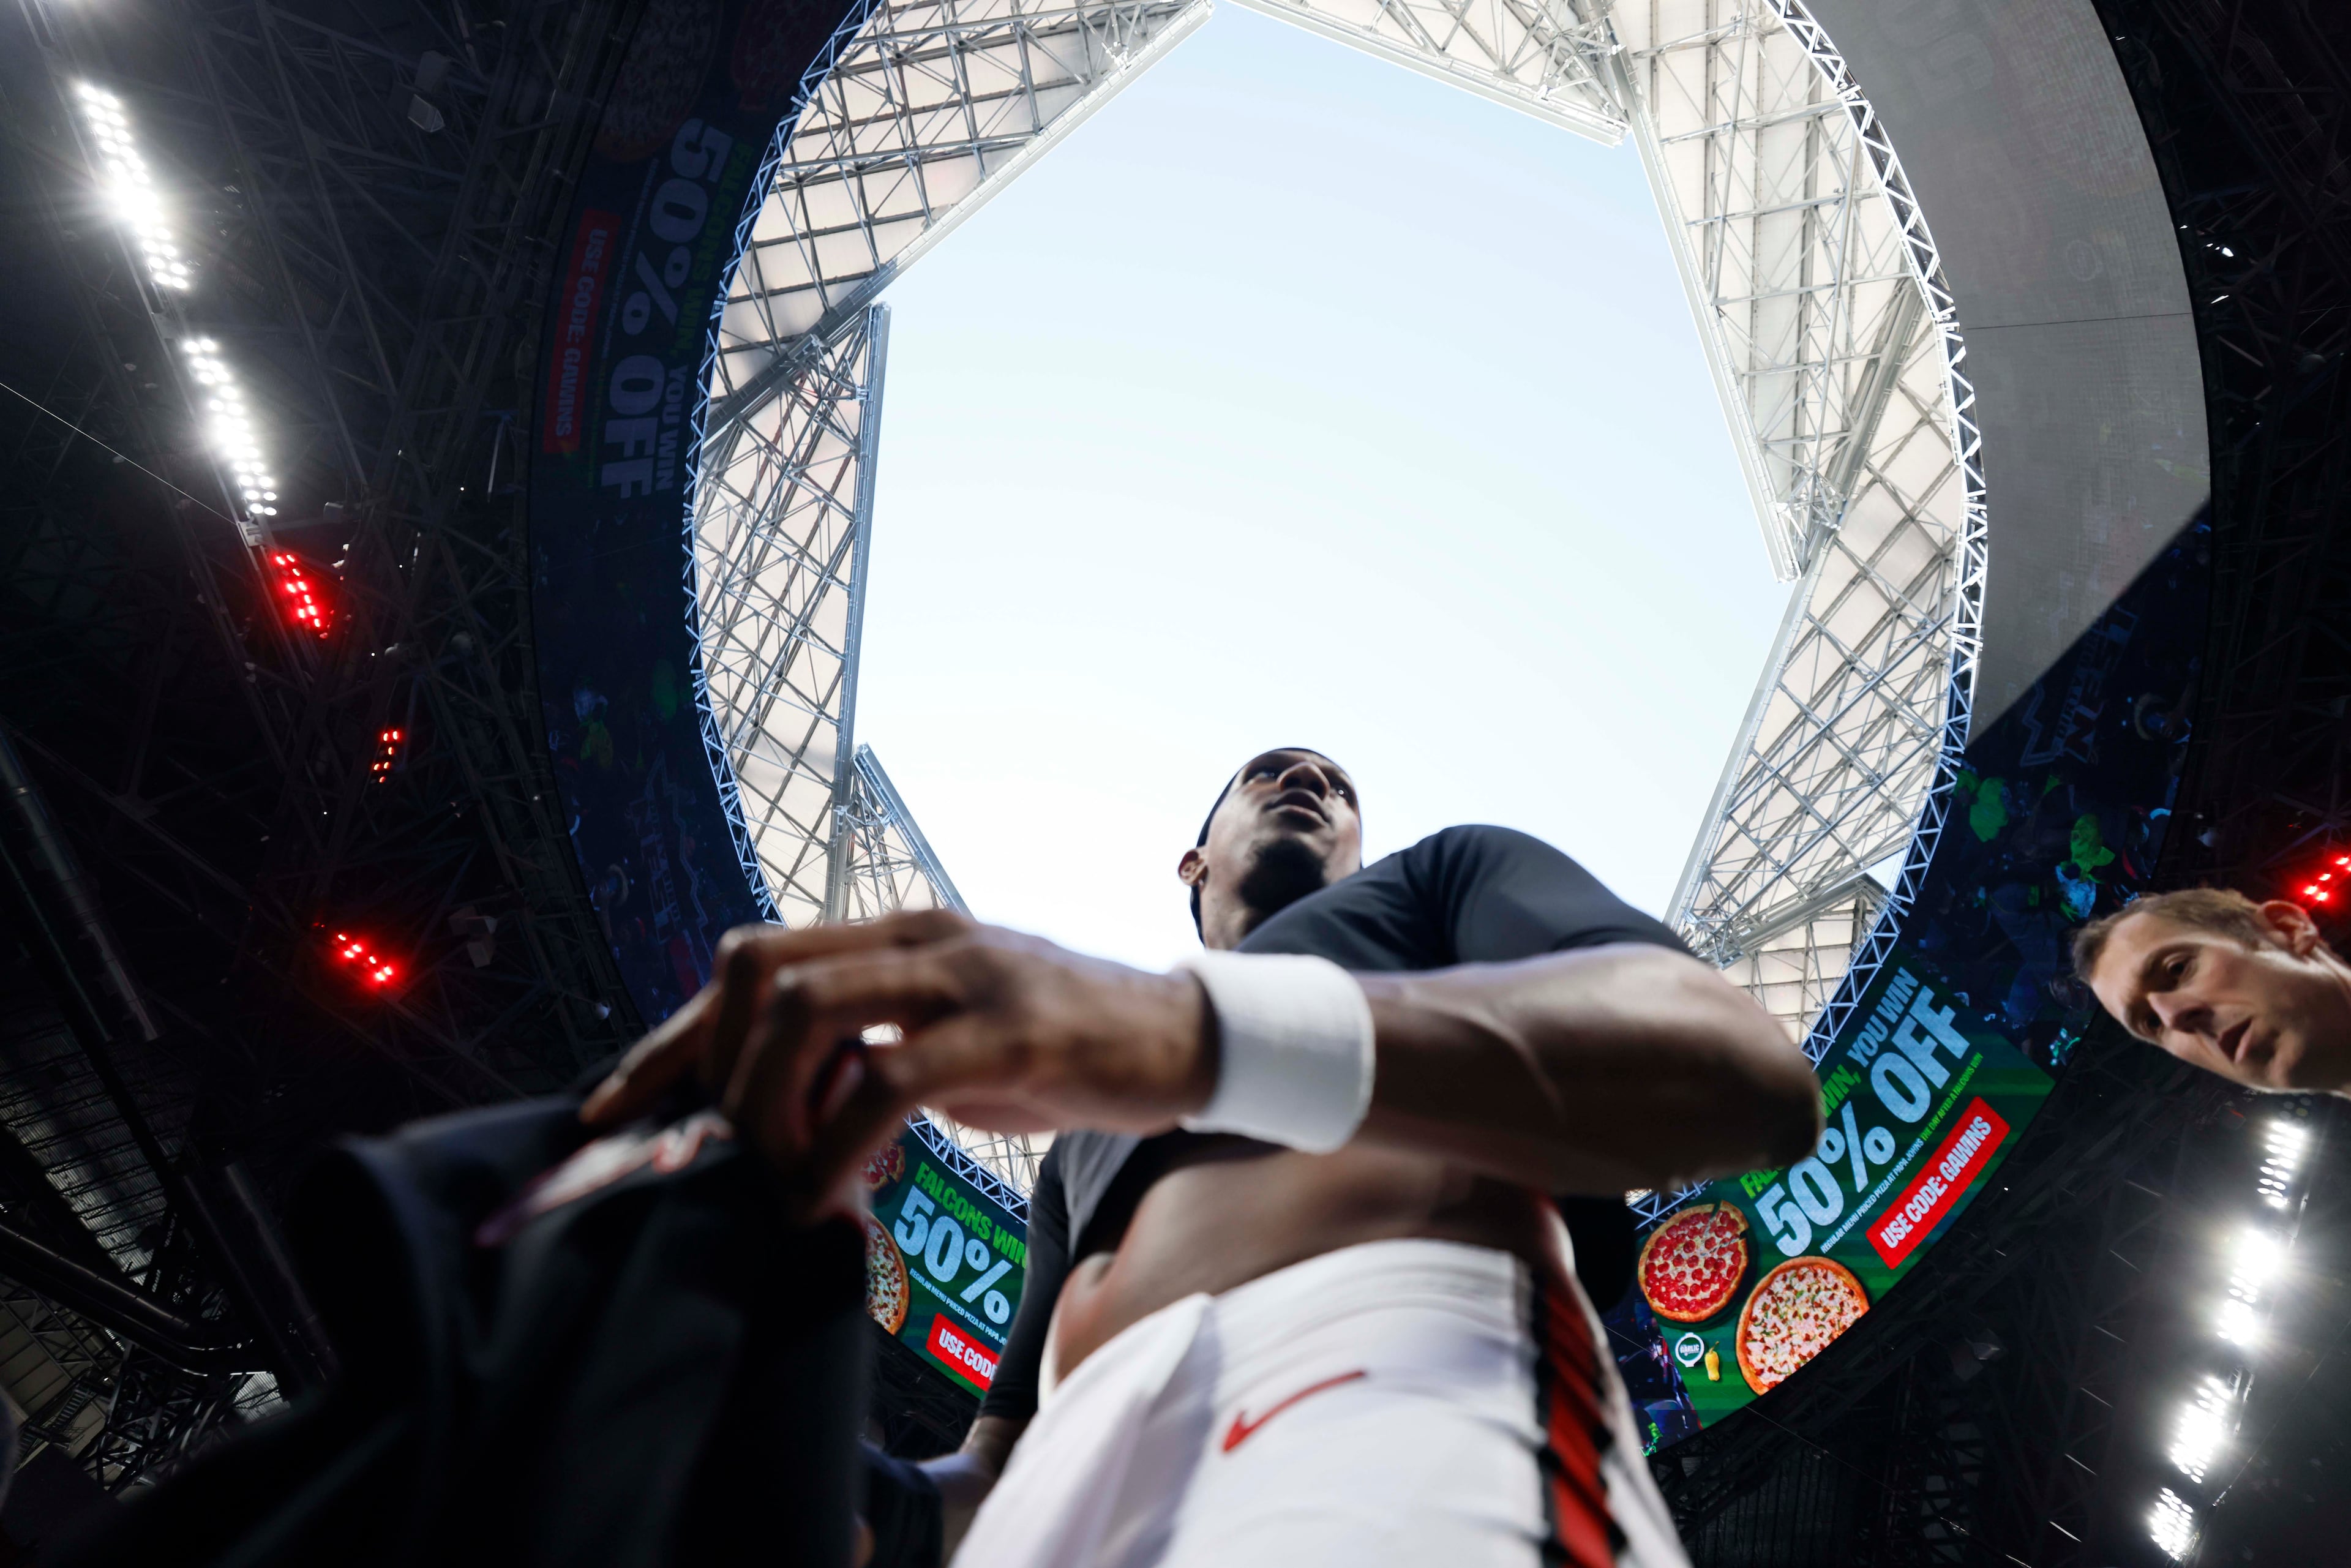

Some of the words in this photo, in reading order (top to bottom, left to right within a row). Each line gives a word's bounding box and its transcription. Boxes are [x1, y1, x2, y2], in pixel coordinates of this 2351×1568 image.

[622, 118, 733, 336] 50%
[692, 141, 754, 282] FALCONS
[581, 228, 608, 273] USE
[567, 276, 594, 343] CODE:
[555, 348, 581, 437] GAWINS
[662, 364, 688, 424] YOU
[601, 354, 666, 499] OFF
[656, 429, 679, 490] WIN
[1847, 1014, 1889, 1068] YOU
[1876, 966, 1919, 1024] WIN
[1970, 1052, 1984, 1068] WIN
[1949, 1092, 1958, 1101] A
[1952, 1066, 1975, 1095] FALCONS
[1755, 1100, 1895, 1257] 50%
[1870, 985, 1970, 1123] OFF
[1929, 1114, 1941, 1130] DAY
[1937, 1097, 1954, 1119] AFTER
[1906, 1138, 1924, 1161] JOHNS
[1920, 1126, 1932, 1141] THE
[1880, 1212, 1914, 1248] USE
[1905, 1176, 1948, 1223] CODE:
[1939, 1116, 1991, 1182] GAWINS
[1886, 1172, 1897, 1185] AT
[1894, 1158, 1909, 1176] PAPA
[915, 1161, 992, 1240] FALCONS
[1873, 1179, 1891, 1198] PIZZA
[1842, 1210, 1860, 1232] MENU
[1856, 1194, 1877, 1217] PRICED
[894, 1185, 1013, 1324] 50%
[1820, 1228, 1845, 1254] REGULAR
[910, 1267, 932, 1291] REGULAR
[931, 1285, 947, 1302] MENU
[946, 1297, 965, 1316] PRICED
[964, 1311, 979, 1327] PIZZA
[978, 1321, 986, 1331] AT
[985, 1326, 999, 1341] PAPA
[939, 1328, 966, 1360] USE
[1679, 1343, 1700, 1354] GARLIC
